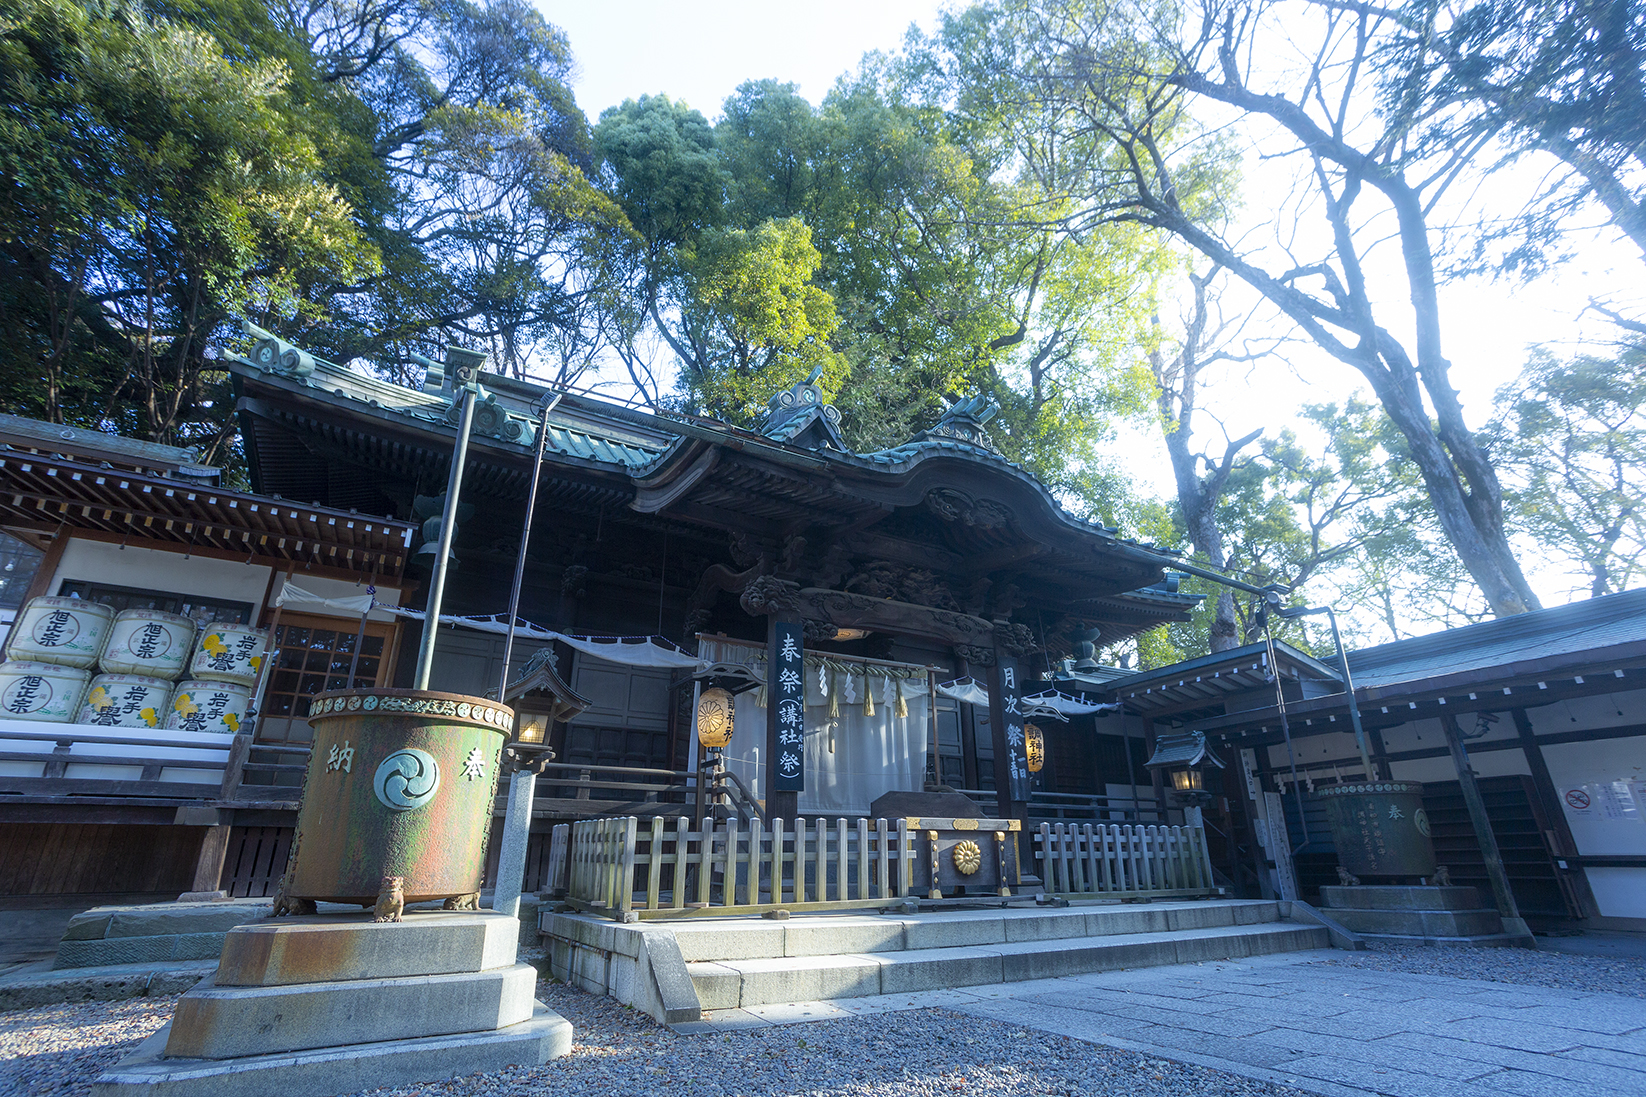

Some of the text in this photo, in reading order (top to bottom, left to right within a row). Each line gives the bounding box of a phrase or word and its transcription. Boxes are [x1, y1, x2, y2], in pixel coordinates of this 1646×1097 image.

[39, 609, 70, 647] 旭正宗
[136, 622, 163, 659] 旭正宗
[9, 675, 43, 714] 旭正宗
[1003, 666, 1025, 747] 月次祭
[325, 740, 486, 782] 奉 納
[1026, 726, 1043, 766] 調神社
[1388, 803, 1405, 820] 奉
